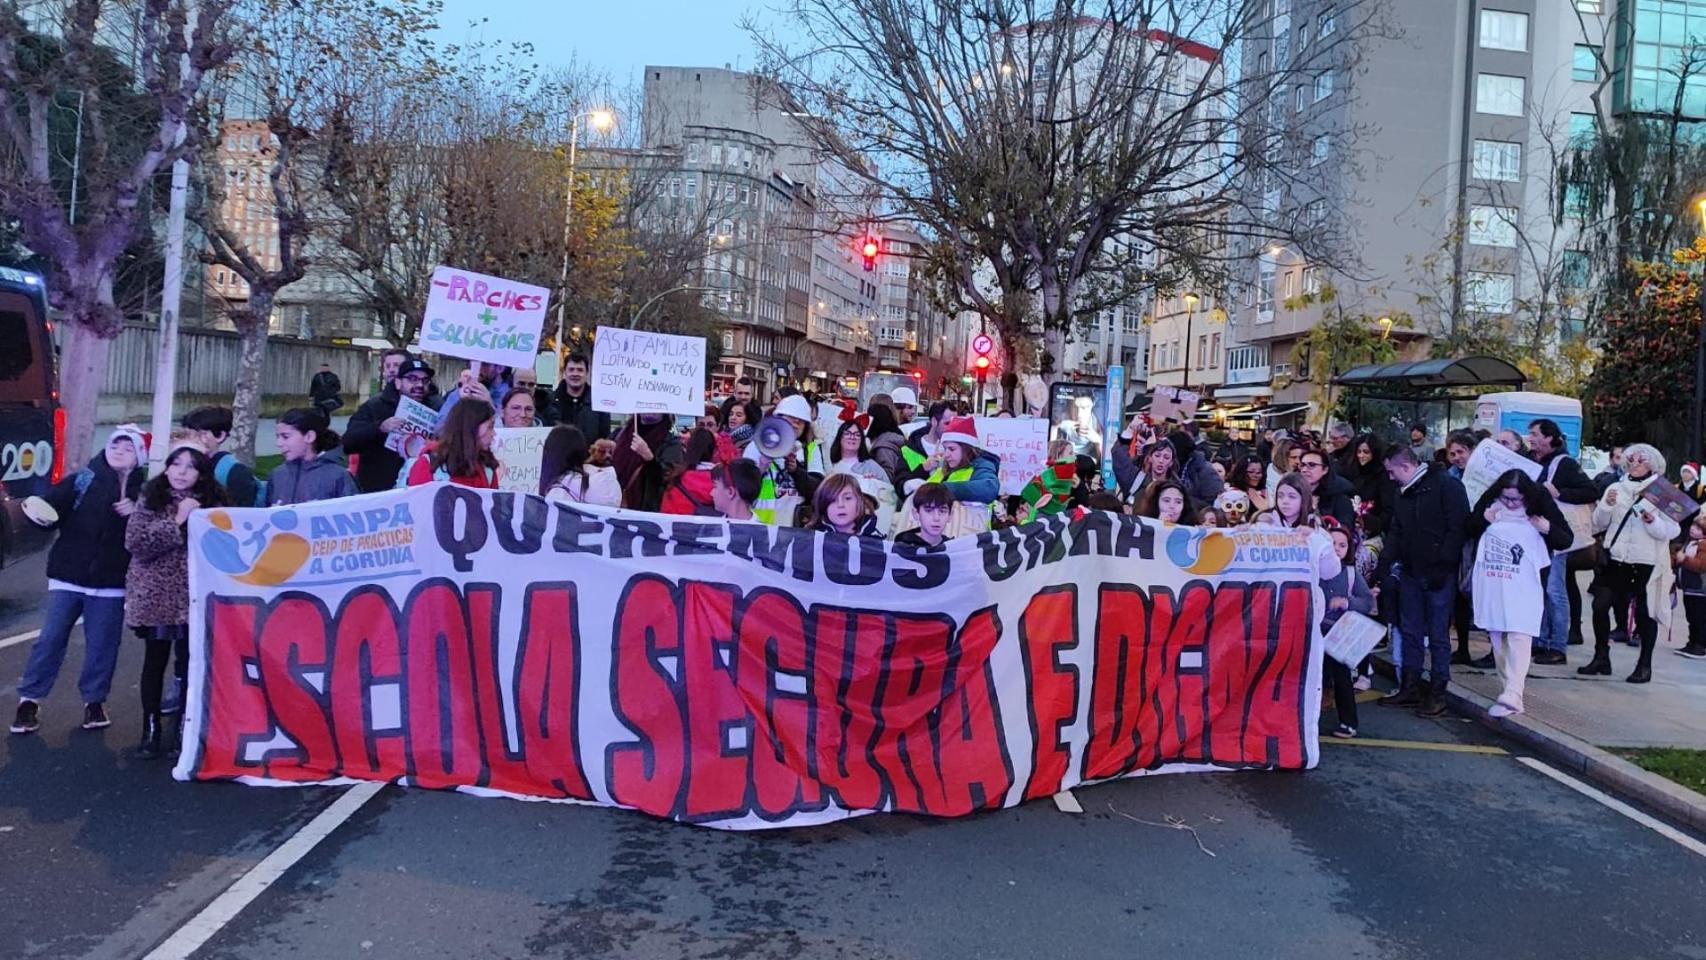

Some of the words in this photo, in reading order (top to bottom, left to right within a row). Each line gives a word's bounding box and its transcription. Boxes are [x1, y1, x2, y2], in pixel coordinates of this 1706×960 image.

[310, 502, 415, 539] ANPA
[312, 539, 337, 556] CEIP
[340, 537, 355, 553] DE
[433, 485, 949, 588] QUEREMOS
[977, 509, 1154, 582] UNHA
[309, 557, 324, 574] A
[1234, 547, 1244, 562] A
[197, 577, 598, 801] ESCOLA
[605, 572, 1014, 821] SEGURA
[1018, 582, 1079, 800] E
[1081, 579, 1313, 780] DIGNA
